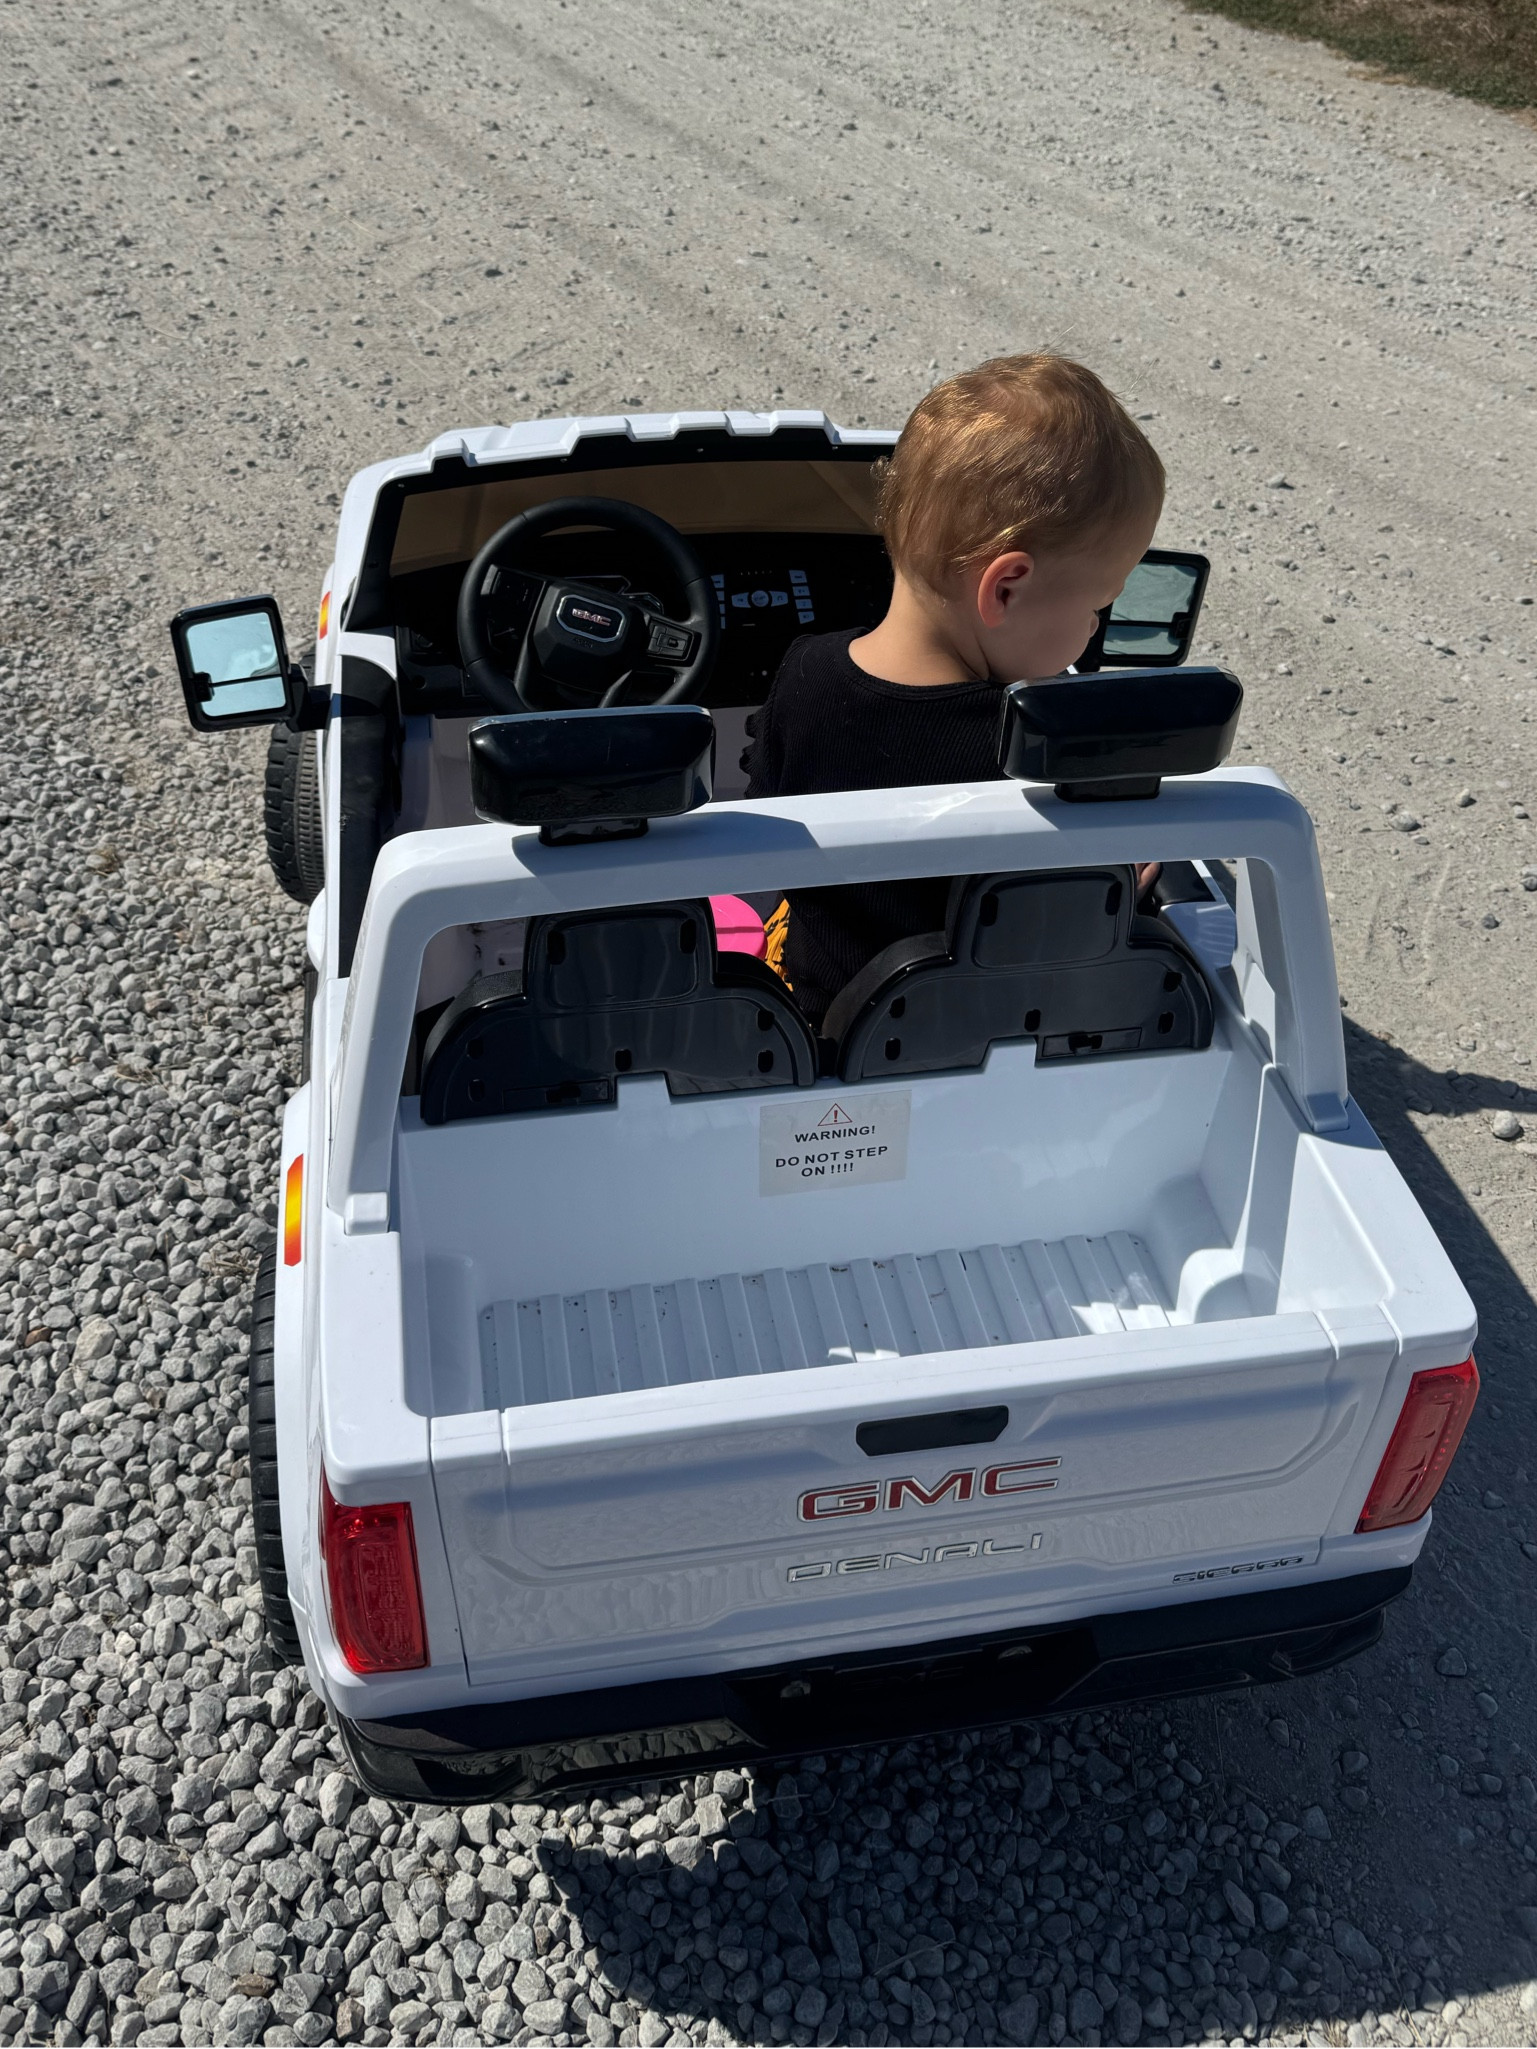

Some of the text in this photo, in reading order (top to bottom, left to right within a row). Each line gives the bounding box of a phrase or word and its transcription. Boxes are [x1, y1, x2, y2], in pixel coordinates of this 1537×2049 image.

[571, 608, 612, 627] GMC
[795, 1125, 876, 1143] WARNING!
[775, 1146, 888, 1168] DO NOT STEP
[801, 1166, 826, 1177] ON
[797, 1456, 1062, 1522] GMC
[787, 1532, 1042, 1583] DENALI
